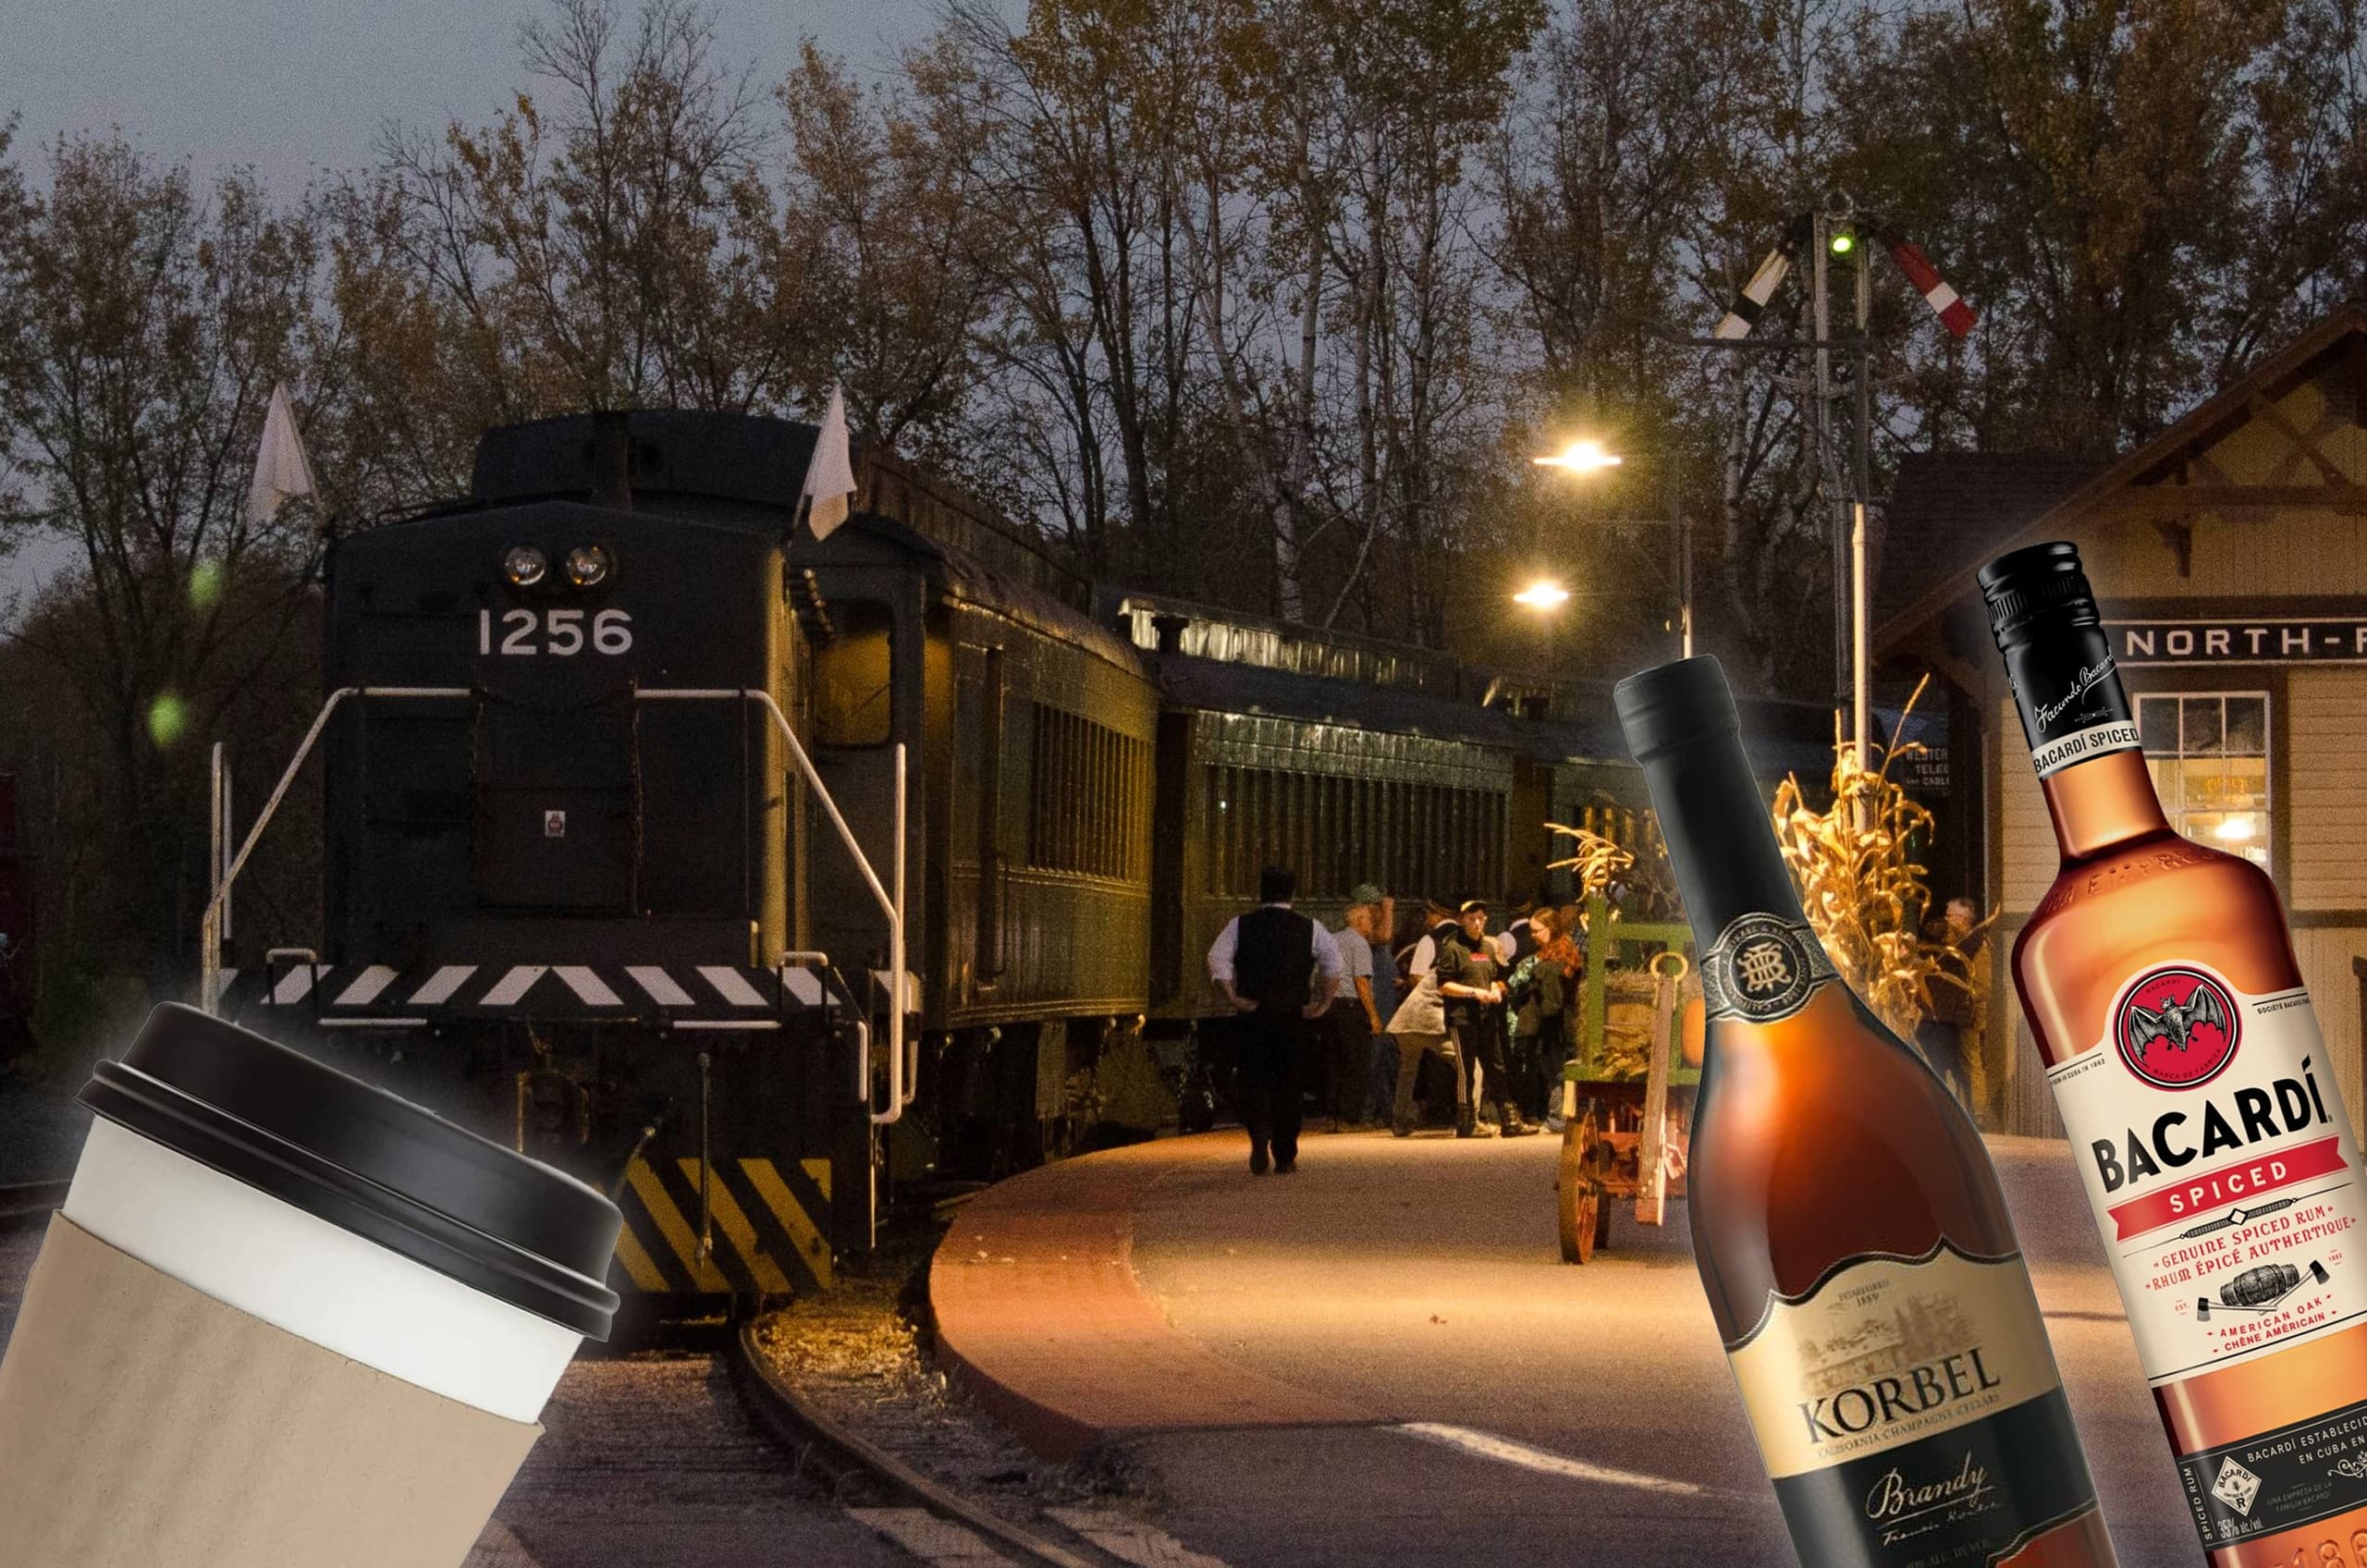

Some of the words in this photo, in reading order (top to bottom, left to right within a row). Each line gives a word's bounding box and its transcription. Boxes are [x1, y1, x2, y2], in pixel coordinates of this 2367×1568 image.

[479, 608, 633, 655] 1256
[2034, 680, 2081, 733] Facundo
[2034, 733, 2087, 774] BACARDÍ
[2089, 728, 2140, 748] SPICED
[2091, 1054, 2328, 1194] BACARDÍ
[2169, 1161, 2287, 1214] SPICED
[2152, 1268, 2191, 1291] RHUM
[2196, 1249, 2243, 1277] ÉPICÉ
[2249, 1216, 2351, 1260] AUTHENTIQUE
[2162, 1237, 2227, 1268] GENUINE
[2231, 1216, 2291, 1245] SPICED
[2296, 1205, 2325, 1225] RUM
[2220, 1311, 2290, 1338] AMERICAN
[2297, 1297, 2323, 1315] OAK
[2225, 1333, 2263, 1352] CHÊNE
[2265, 1312, 2325, 1339] AMÉRICAIN
[1798, 1347, 2001, 1444] KORBEL
[2247, 1439, 2297, 1464] BACARDÍ
[2299, 1452, 2313, 1464] EN
[2316, 1441, 2349, 1459] CUBA
[2350, 1434, 2366, 1447] EN
[1866, 1451, 1988, 1518] Brandy
[2183, 1466, 2198, 1493] RUM
[2193, 1496, 2213, 1541] SPICED
[2236, 1497, 2247, 1509] R
